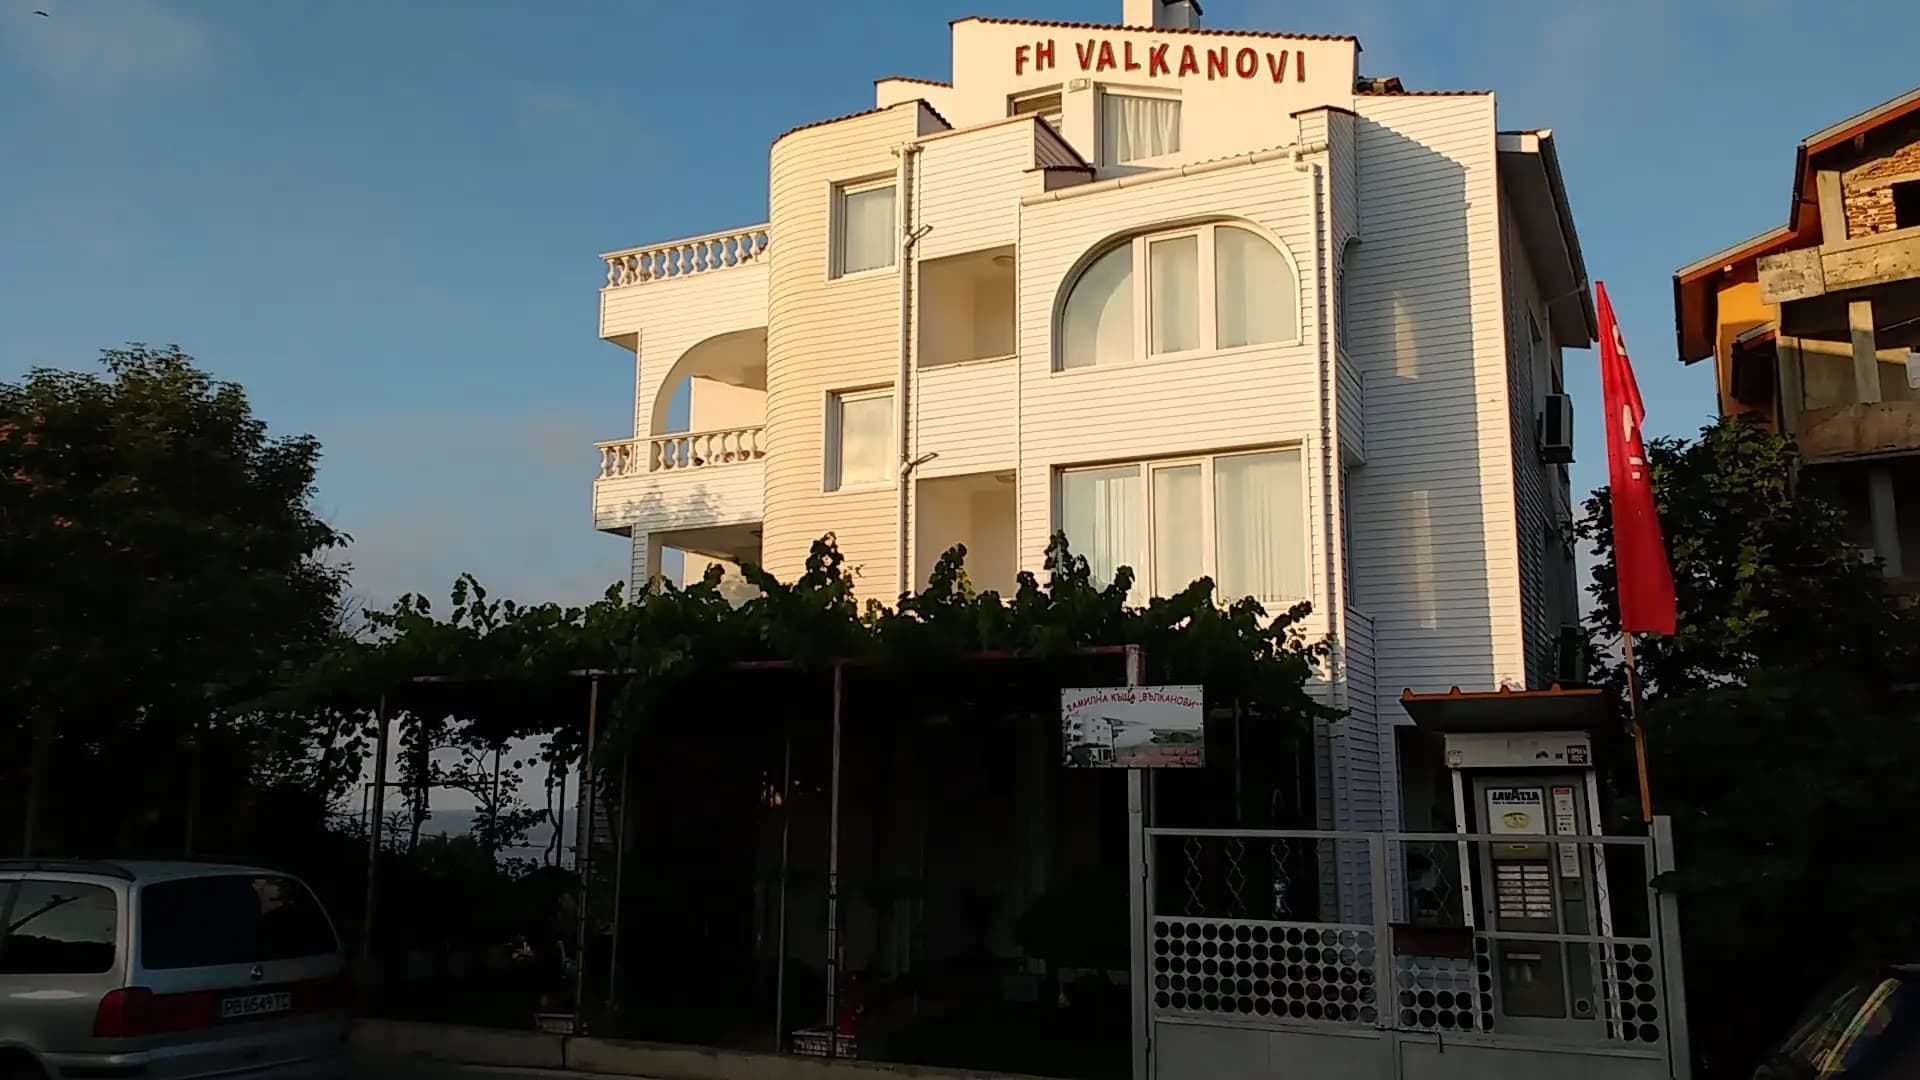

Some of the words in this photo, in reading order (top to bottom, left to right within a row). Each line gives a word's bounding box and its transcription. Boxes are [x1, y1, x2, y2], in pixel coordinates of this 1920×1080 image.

[1015, 39, 1055, 76] FH
[1075, 39, 1306, 83] VALKANOVI
[1492, 789, 1540, 801] LAVAZZA
